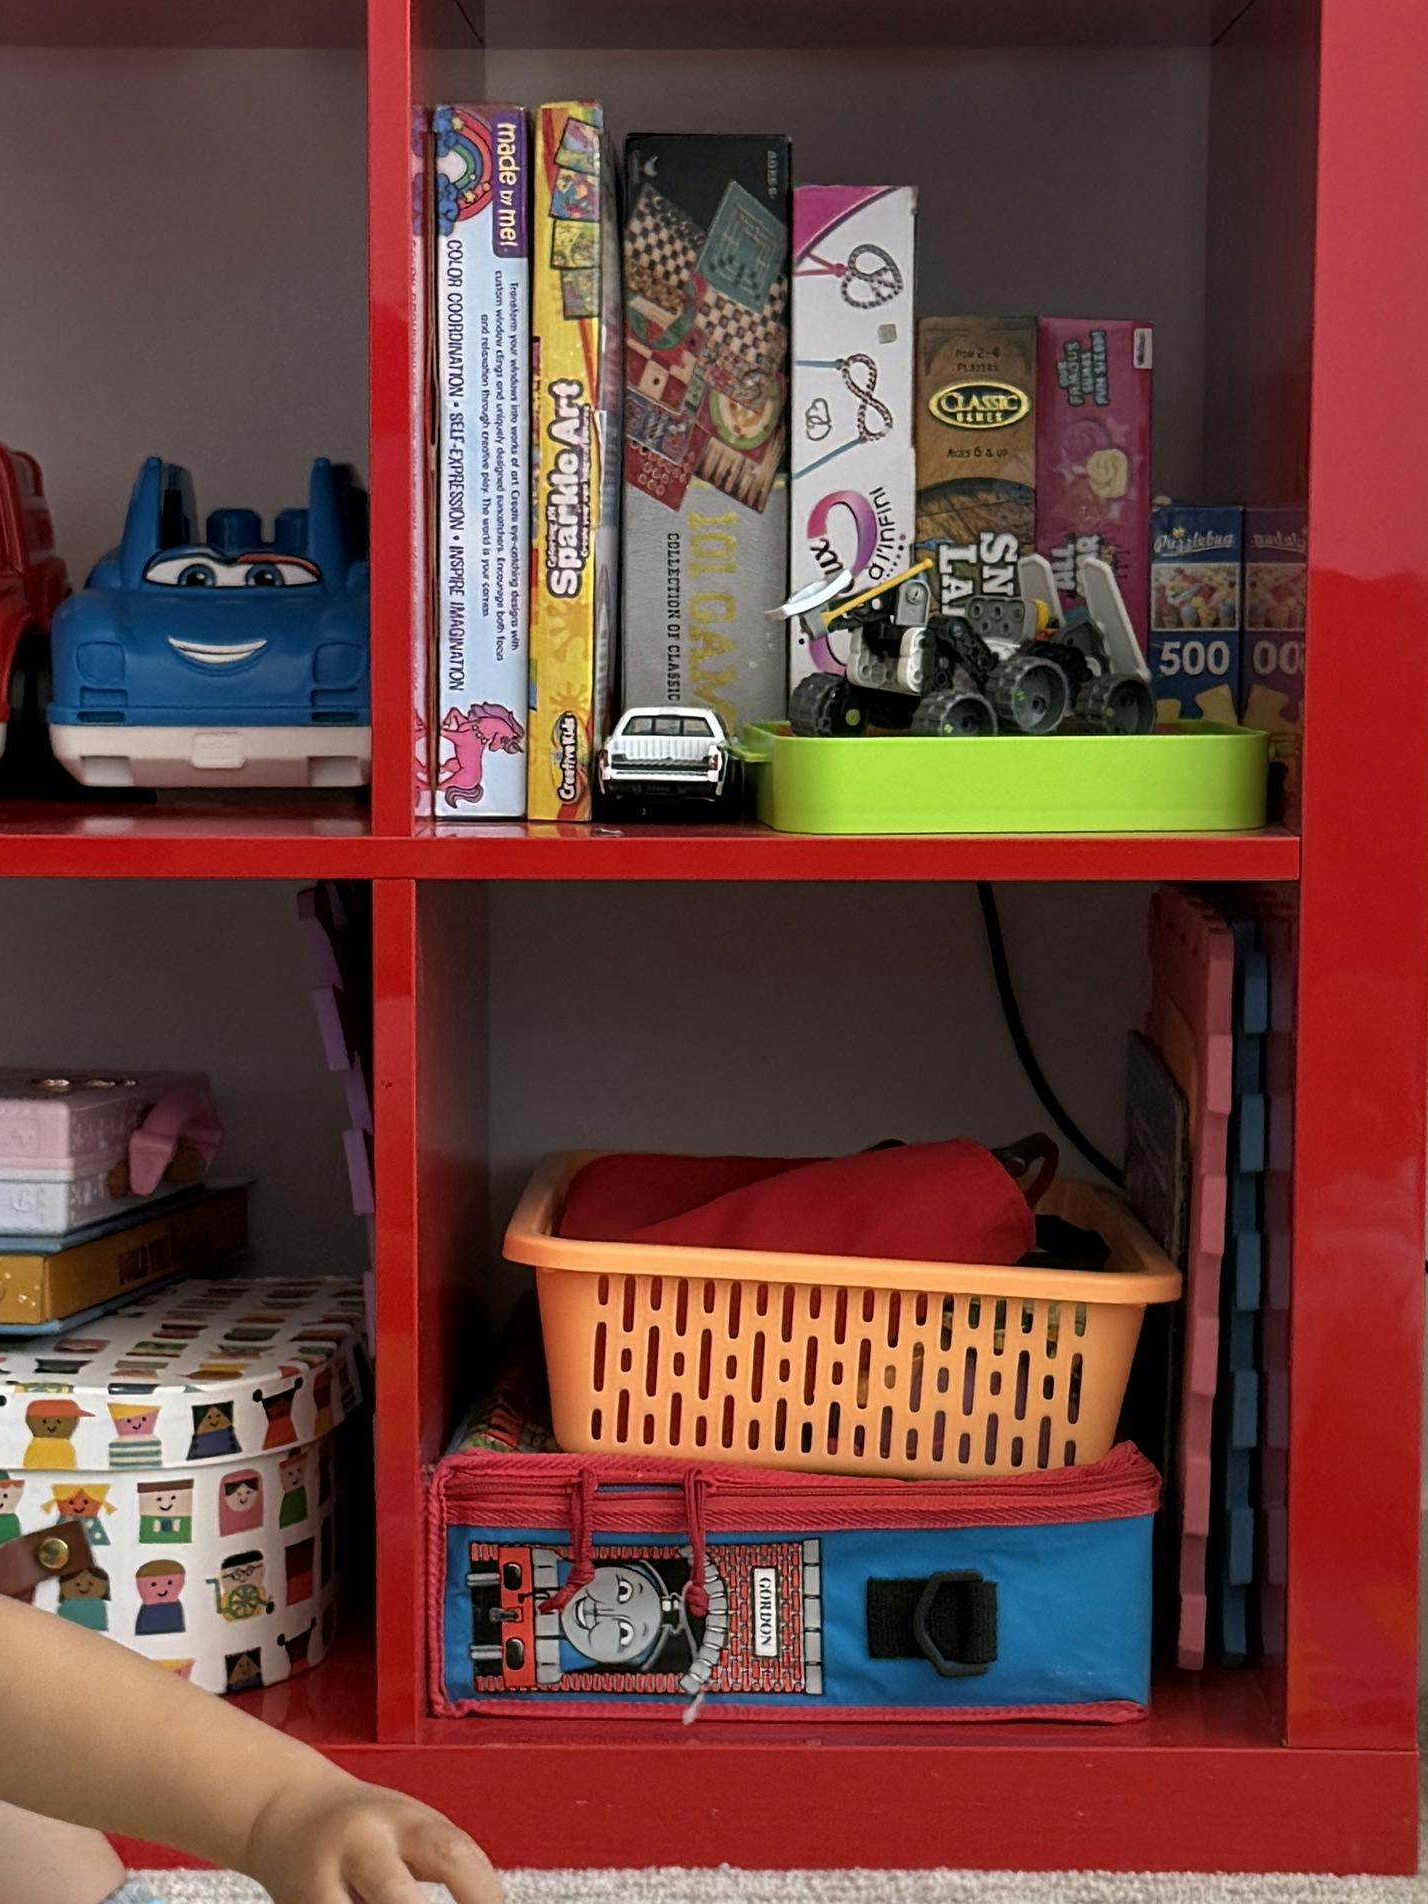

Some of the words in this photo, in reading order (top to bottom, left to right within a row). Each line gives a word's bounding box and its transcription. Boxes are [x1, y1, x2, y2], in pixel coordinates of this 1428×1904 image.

[497, 123, 520, 185] made
[498, 209, 518, 247] me!
[447, 240, 463, 287] COLOR
[495, 270, 504, 306] custom
[481, 315, 490, 334] and
[495, 309, 504, 346] window
[447, 293, 463, 397] COORDINATION
[481, 337, 490, 386] relaxation
[508, 335, 518, 355] your
[495, 381, 505, 400] and
[510, 359, 520, 402] windows
[1065, 342, 1084, 405] FAMOUS
[479, 389, 490, 428] through
[511, 405, 520, 423] into
[549, 381, 581, 445] Art
[940, 391, 1019, 413] CLASSIC
[494, 403, 505, 444] uniquely
[511, 426, 520, 454] works
[481, 431, 491, 469] creative
[494, 447, 505, 491] designed
[449, 413, 465, 530] SELF-EXPRESSION
[481, 498, 491, 514] The
[549, 452, 583, 596] Sparkle
[481, 517, 491, 545] world
[687, 512, 738, 578] 101
[449, 546, 464, 596] INSPIRE
[479, 558, 490, 580] your
[667, 533, 680, 619] COLLECTION
[496, 610, 506, 633] both
[511, 630, 520, 650] with
[667, 624, 680, 640] OF
[449, 602, 465, 690] IMAGINATION
[496, 636, 506, 661] focus
[1159, 639, 1230, 676] 500
[667, 645, 680, 702] CLASSIC
[561, 718, 576, 745] Kids
[559, 745, 576, 800] Creative
[759, 1576, 773, 1647] GORDON
